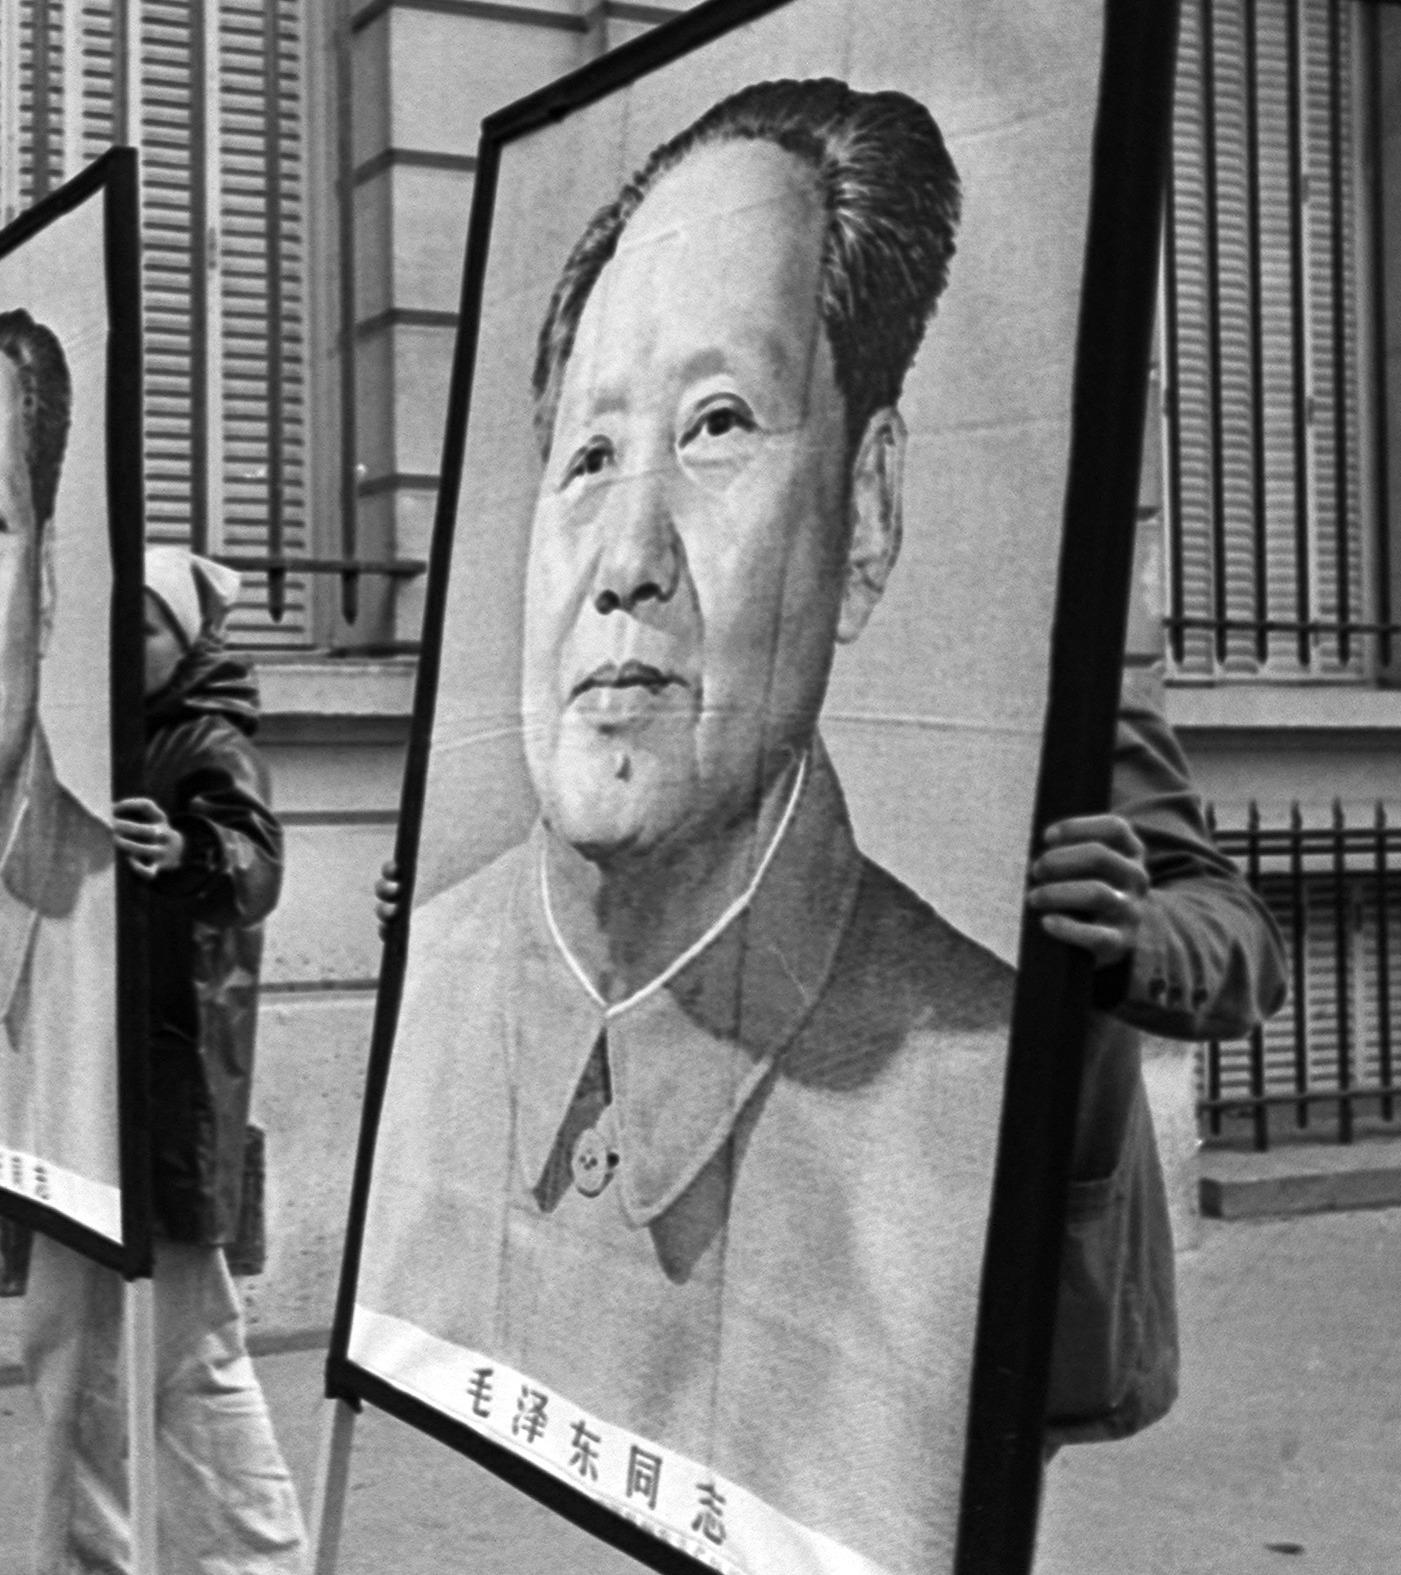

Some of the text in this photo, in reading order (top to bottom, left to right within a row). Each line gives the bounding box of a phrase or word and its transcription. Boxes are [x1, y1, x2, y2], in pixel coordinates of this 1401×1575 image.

[465, 1366, 728, 1547] 毛泽东同志
